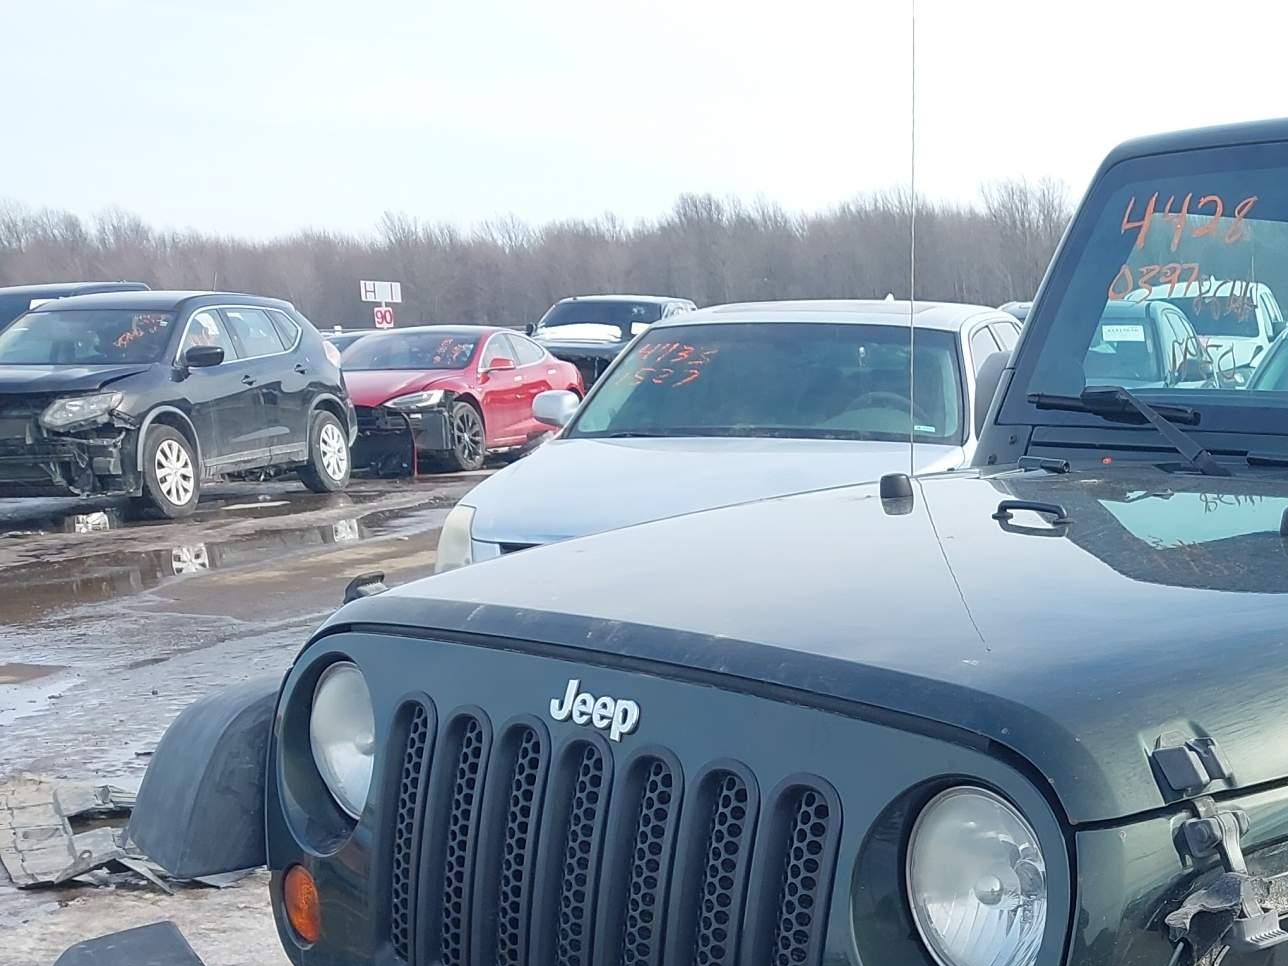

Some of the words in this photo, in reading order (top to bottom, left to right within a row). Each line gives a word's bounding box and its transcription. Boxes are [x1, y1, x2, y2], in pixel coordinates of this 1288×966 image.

[1121, 191, 1259, 252] 4428
[1108, 263, 1200, 304] 0397
[375, 310, 393, 325] 90
[550, 679, 640, 742] Jeep
